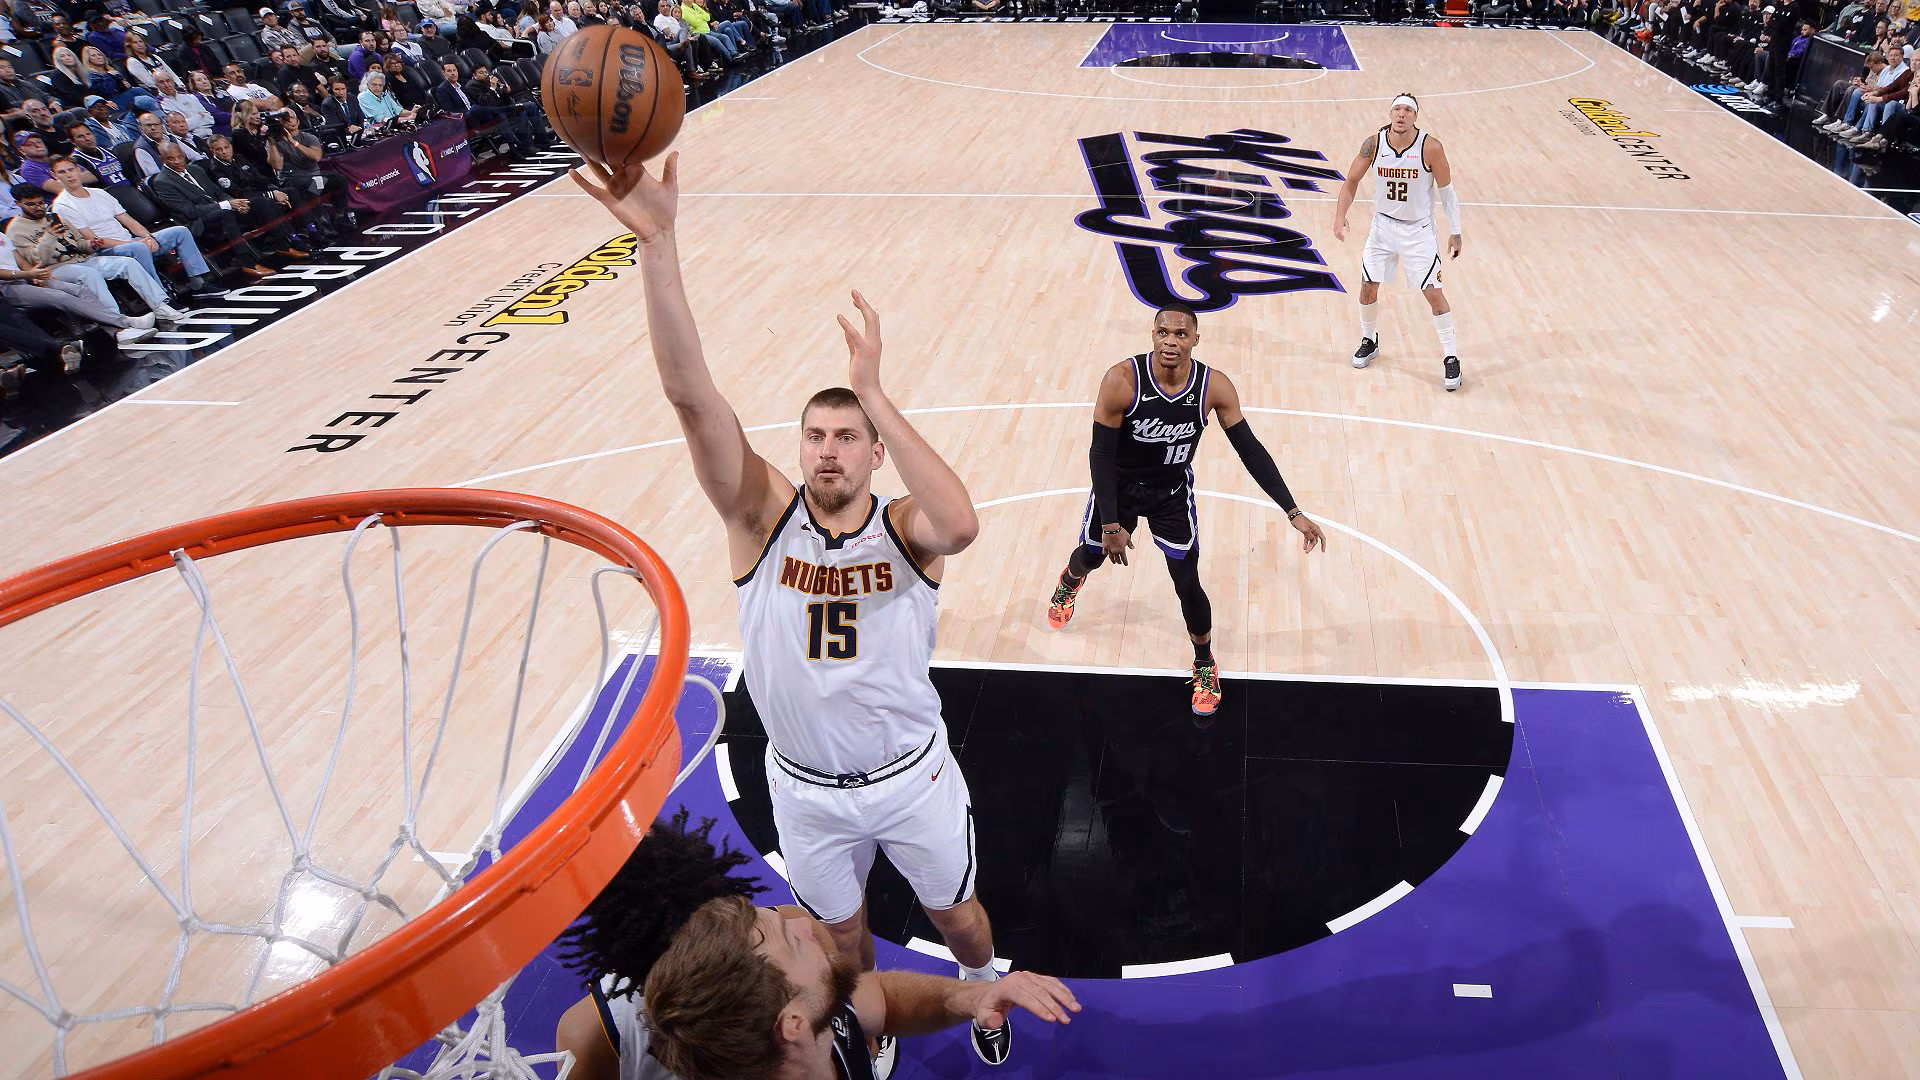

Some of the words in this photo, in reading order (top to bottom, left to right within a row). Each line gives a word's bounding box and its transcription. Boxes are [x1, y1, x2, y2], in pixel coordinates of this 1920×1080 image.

[610, 43, 645, 133] Wilson
[1377, 166, 1419, 179] NUGGETS
[1612, 138, 1691, 180] CENTER
[366, 178, 379, 188] NBC
[380, 168, 400, 185] peacock
[1386, 181, 1408, 202] 32
[1074, 128, 1347, 313] Kings
[499, 262, 563, 292] Credit
[117, 246, 402, 350] PROUD
[443, 295, 508, 327] Union
[286, 331, 510, 453] CENTER
[1132, 418, 1196, 443] Kings
[1163, 443, 1191, 465] 18
[780, 556, 893, 597] NUGGETS
[806, 601, 859, 661] 15
